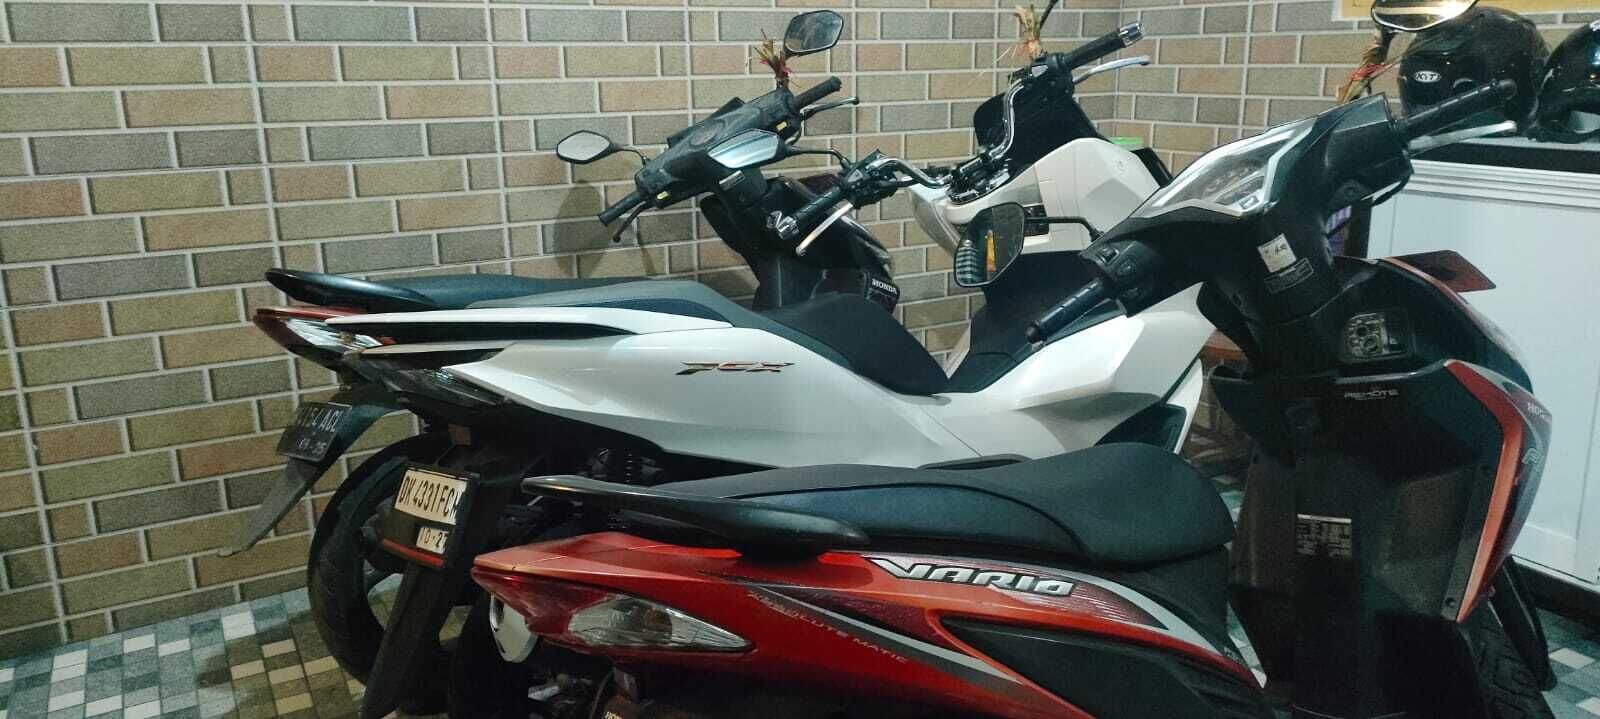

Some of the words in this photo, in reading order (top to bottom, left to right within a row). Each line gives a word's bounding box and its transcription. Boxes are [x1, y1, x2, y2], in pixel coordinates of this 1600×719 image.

[872, 278, 897, 294] HONDA
[675, 361, 795, 376] PCX
[1344, 389, 1399, 398] REMOTE
[399, 475, 416, 506] DK
[413, 479, 441, 513] 4331
[866, 556, 1075, 597] VARIO
[852, 637, 910, 665] MATIC
